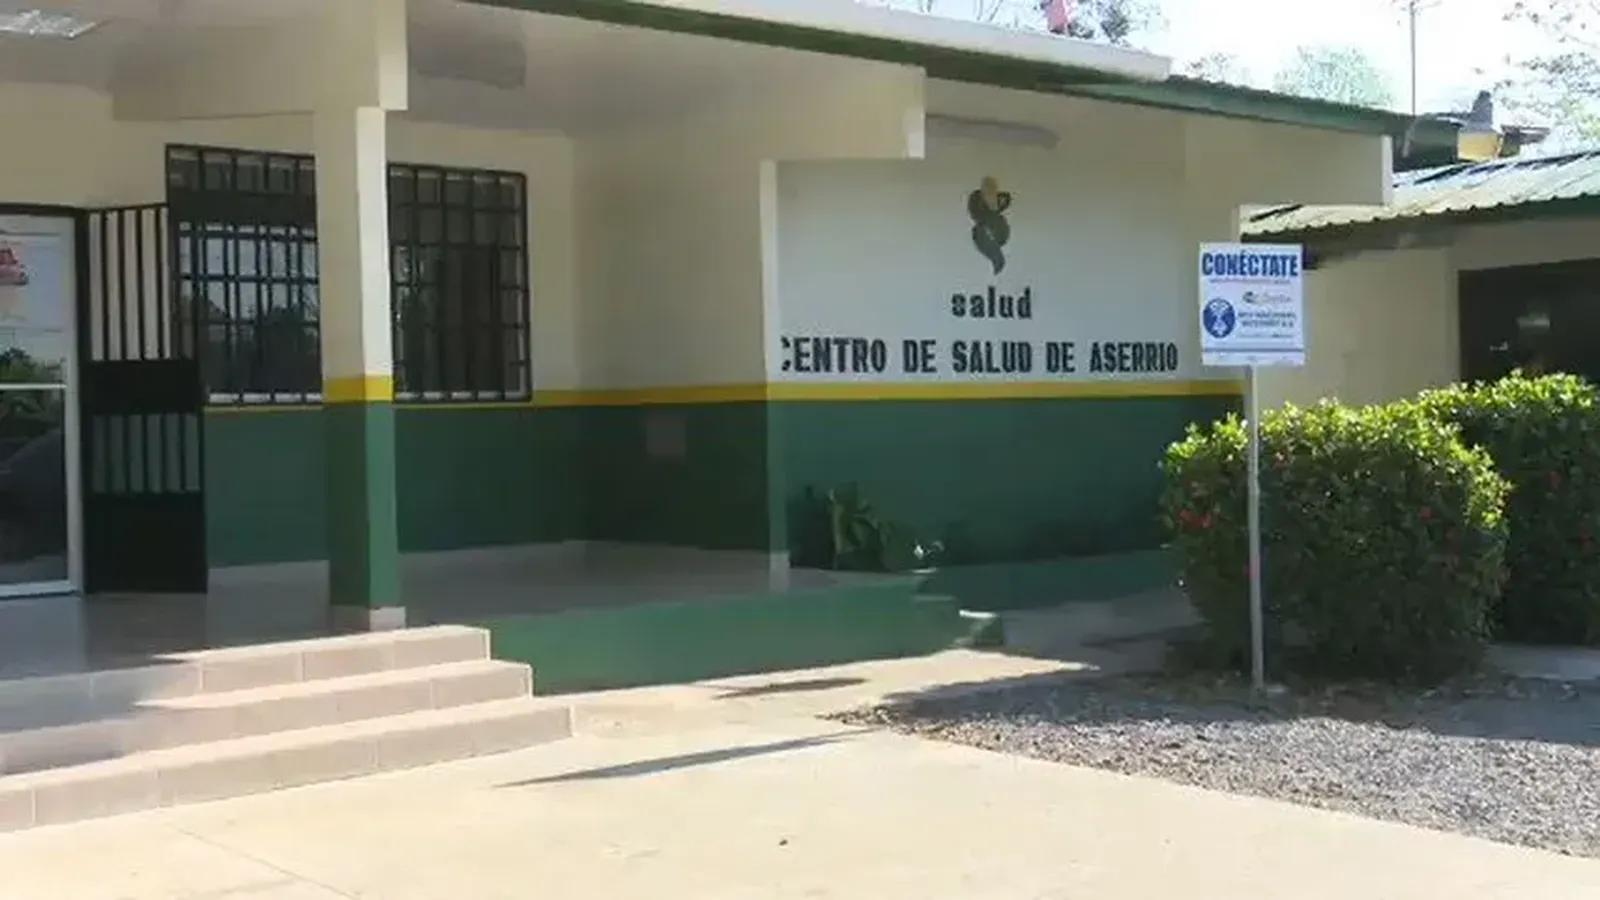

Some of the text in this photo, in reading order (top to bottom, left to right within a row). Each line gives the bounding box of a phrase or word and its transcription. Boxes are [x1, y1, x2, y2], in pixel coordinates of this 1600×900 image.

[1202, 250, 1298, 276] CONÉCTATE
[951, 286, 1032, 318] salud
[903, 339, 937, 373] DE
[952, 340, 1032, 373] SALUD
[1046, 341, 1075, 373] DE
[1089, 341, 1178, 373] ASERRIO
